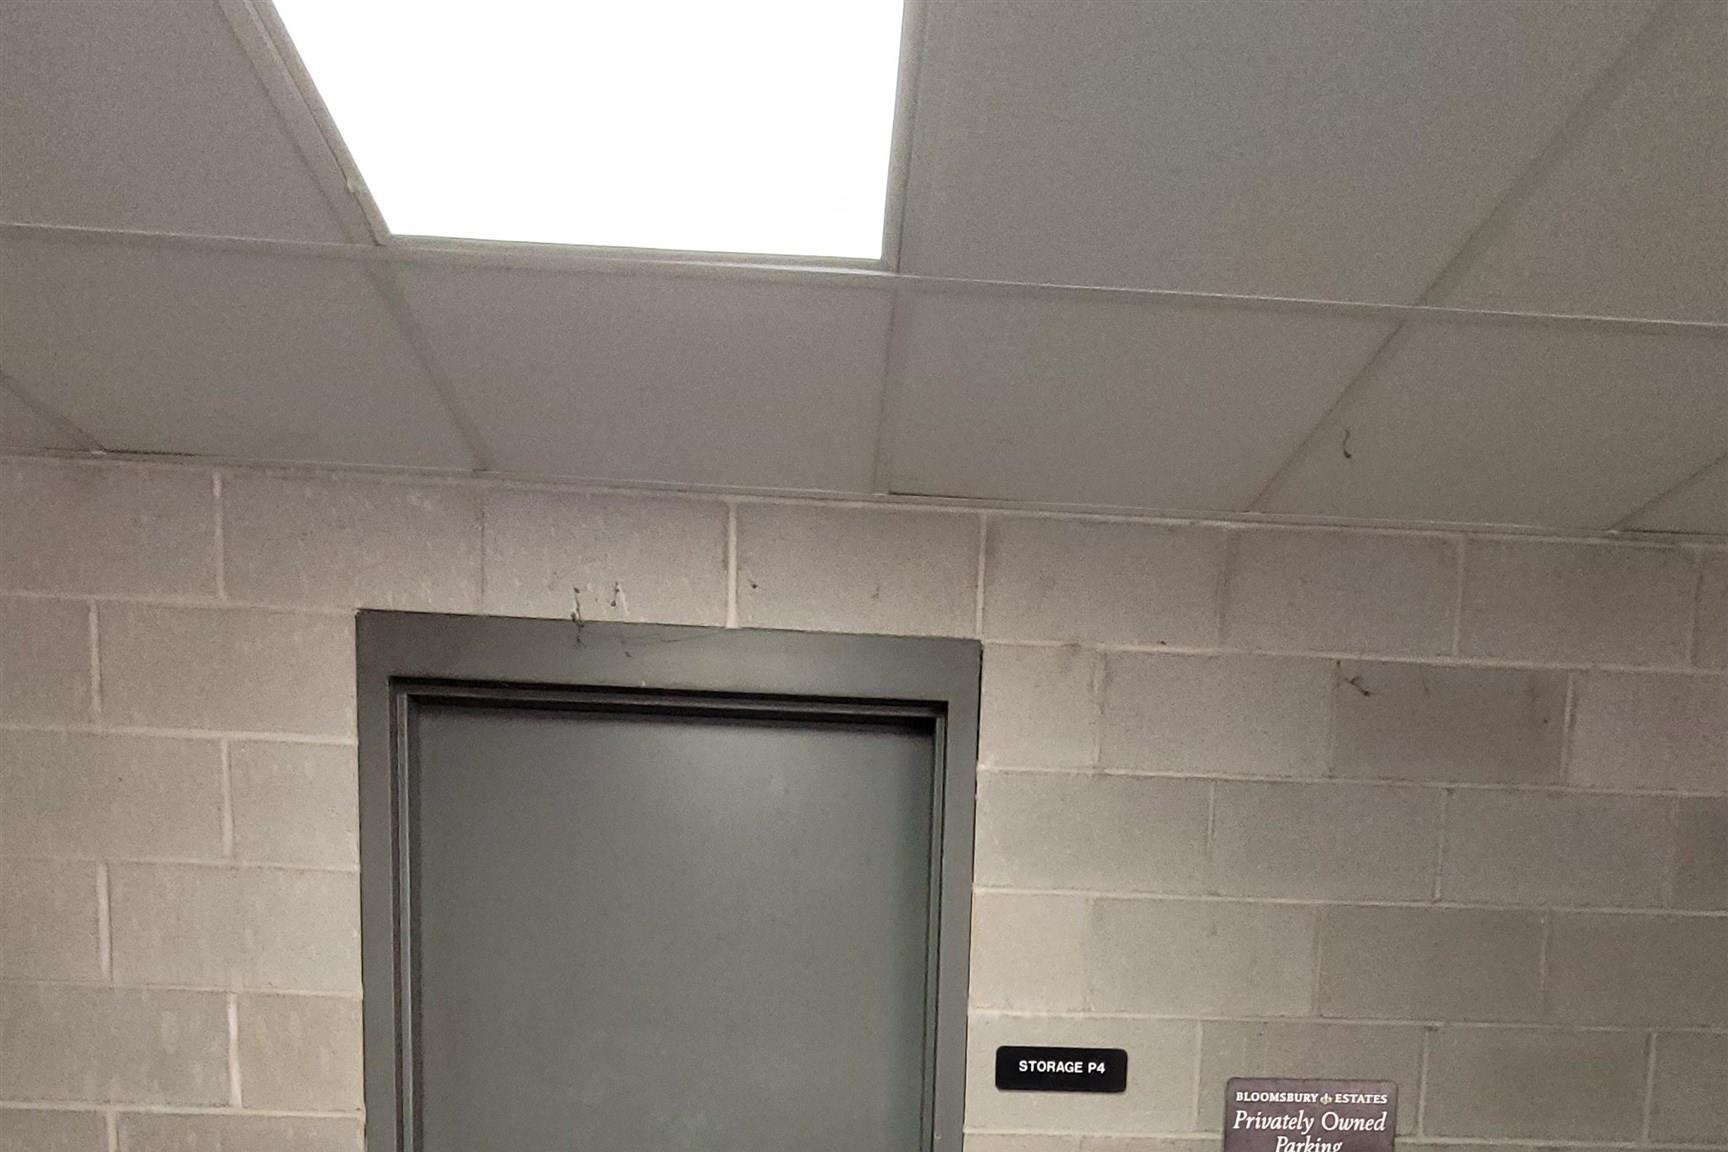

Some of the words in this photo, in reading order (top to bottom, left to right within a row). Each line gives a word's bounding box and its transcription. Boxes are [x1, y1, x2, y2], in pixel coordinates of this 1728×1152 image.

[1018, 1060, 1083, 1073] STORAGE
[1087, 1062, 1106, 1074] P4
[1236, 1091, 1319, 1103] BLOOMSBURY
[1334, 1093, 1388, 1104] ESTATES
[1232, 1110, 1314, 1135] Privately
[1321, 1111, 1388, 1131] Owned
